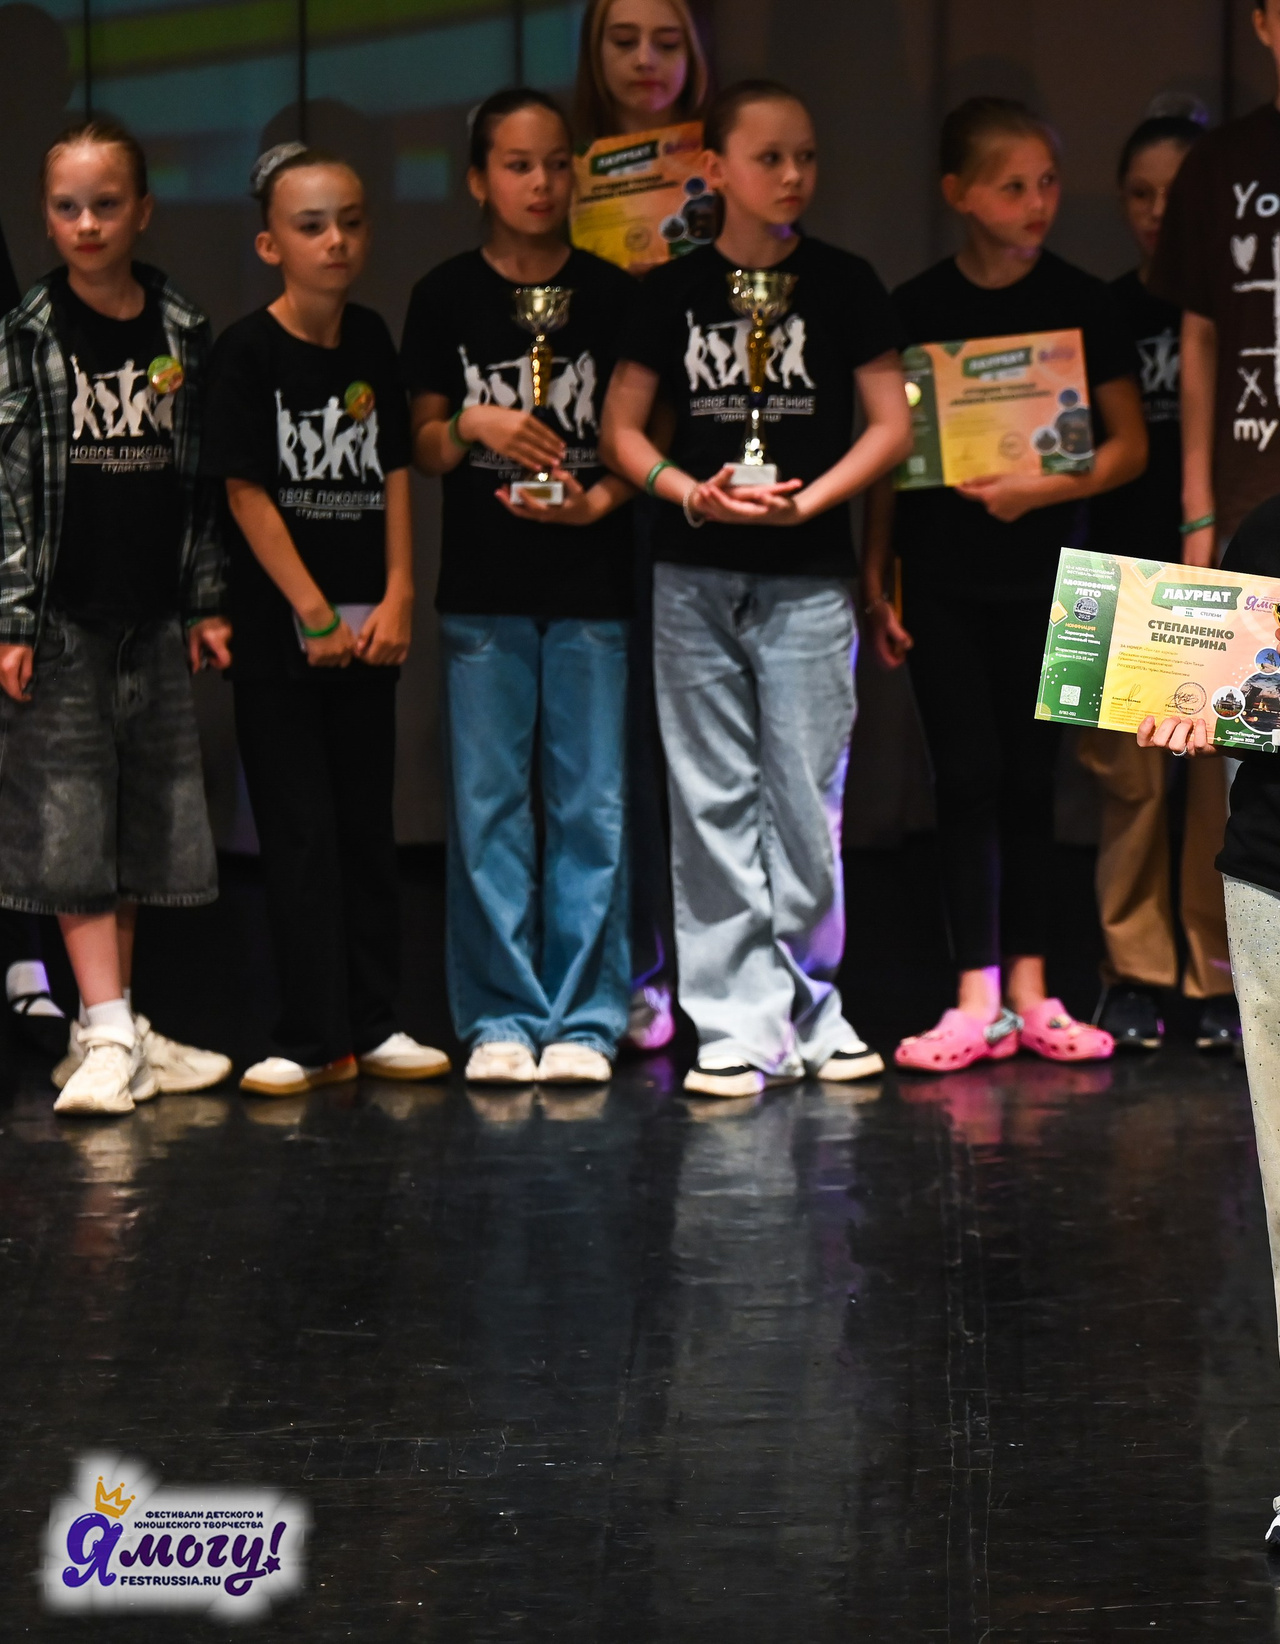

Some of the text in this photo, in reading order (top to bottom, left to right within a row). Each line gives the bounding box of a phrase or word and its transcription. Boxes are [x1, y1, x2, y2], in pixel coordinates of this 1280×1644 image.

[1233, 415, 1280, 453] my
[69, 444, 115, 460] НОВОЕ
[278, 487, 384, 506] ОВОЕ ПОКОЛЕНИ
[1075, 587, 1102, 598] ЛЕТО
[1162, 588, 1231, 603] ЛАУРЕАТ
[1147, 619, 1235, 641] СТЕПАНЕНКО
[1150, 632, 1227, 652] ЕКАТЕРИНА
